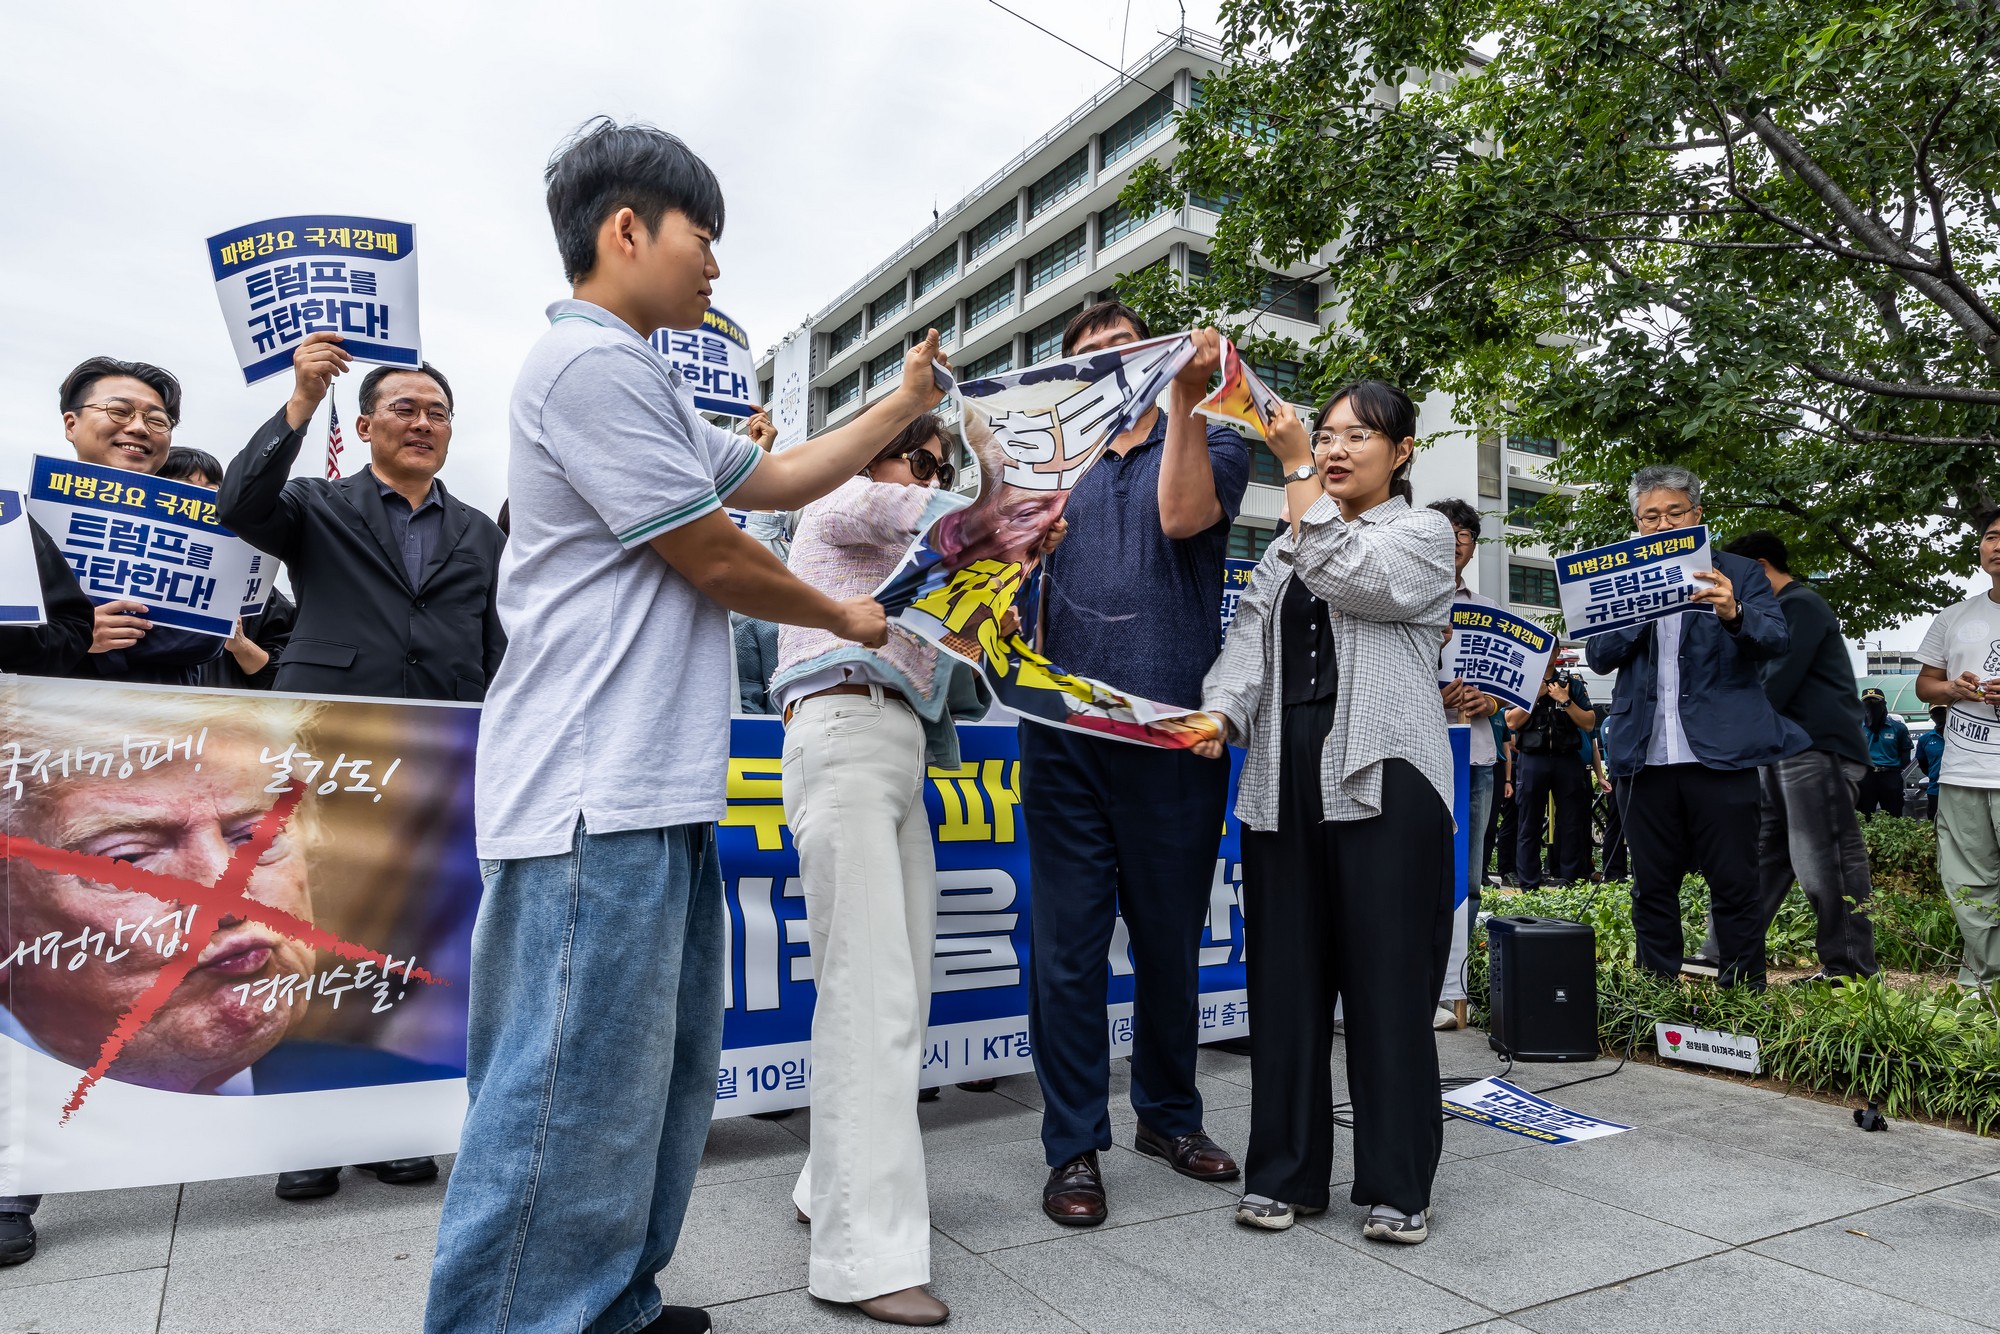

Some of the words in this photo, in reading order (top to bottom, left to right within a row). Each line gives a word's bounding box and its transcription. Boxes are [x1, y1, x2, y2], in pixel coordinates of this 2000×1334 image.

[221, 230, 297, 266] 파병강요
[304, 227, 398, 254] 국제깡패
[245, 262, 377, 311] 트럼프를
[248, 298, 389, 354] 규탄한다!
[667, 358, 749, 400] 한다!
[48, 472, 146, 509] 파병강요
[155, 491, 220, 526] 국제깡
[65, 511, 214, 570] 트럼프를
[1568, 552, 1630, 576] 파병강요
[1633, 535, 1695, 560] 국제깡패
[63, 551, 217, 611] 규탄한다!
[1232, 569, 1252, 584] 국제
[1589, 566, 1684, 602] 트럼프를
[1585, 584, 1693, 624] 규탄한다!
[1453, 611, 1492, 628] 파병강요
[1496, 618, 1544, 651] 국제깡패
[1460, 634, 1525, 668] 트럼프를
[1453, 658, 1525, 692] 규탄한다!
[1950, 715, 1959, 732] ALL
[1965, 722, 1990, 742] STAR
[0, 726, 209, 801] 국제깡패!
[259, 743, 402, 803] 날강도!
[233, 954, 416, 1014] 경제수탈!
[716, 1066, 738, 1100] 월
[746, 1058, 812, 1093] 10일(
[983, 1031, 1031, 1060] KT광
[1198, 1003, 1218, 1030] 번
[1685, 1040, 1710, 1052] 정원을
[1711, 1044, 1752, 1060] 아껴주세요
